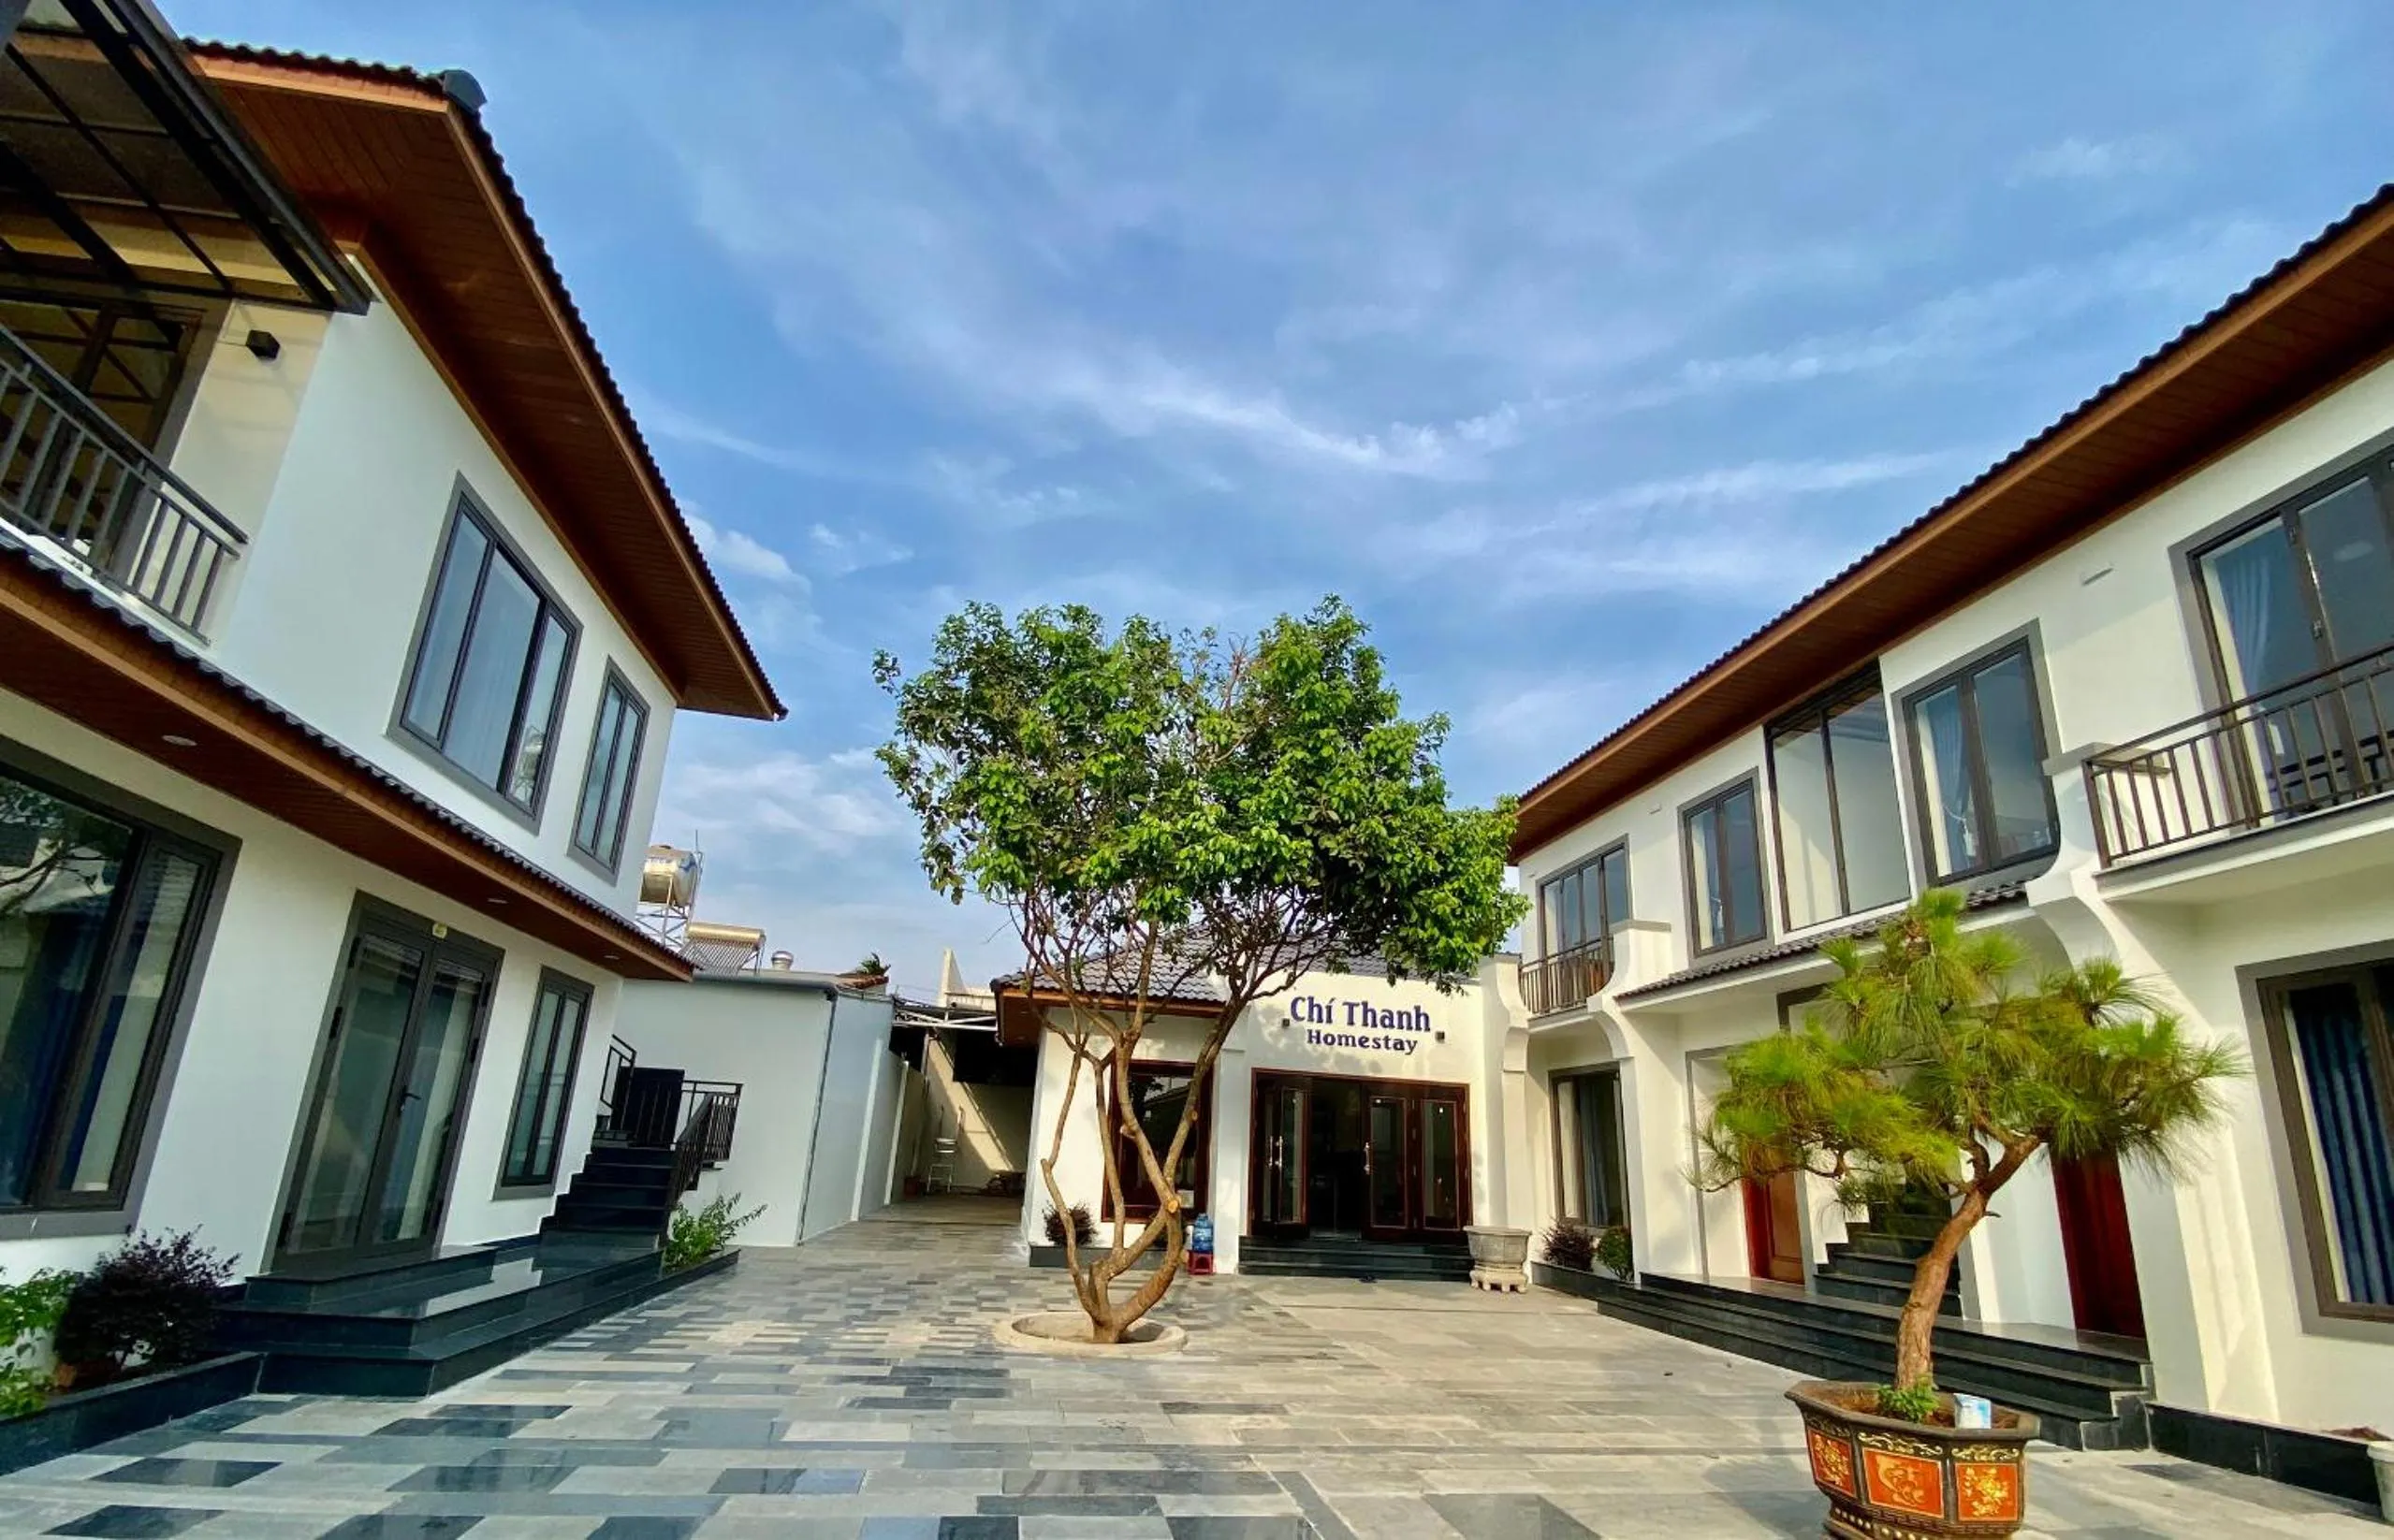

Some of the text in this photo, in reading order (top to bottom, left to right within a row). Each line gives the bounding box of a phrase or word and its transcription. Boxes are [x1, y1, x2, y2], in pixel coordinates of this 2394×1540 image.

[1291, 995, 1431, 1032] Chí Thanh
[1306, 1029, 1418, 1055] Homestay
